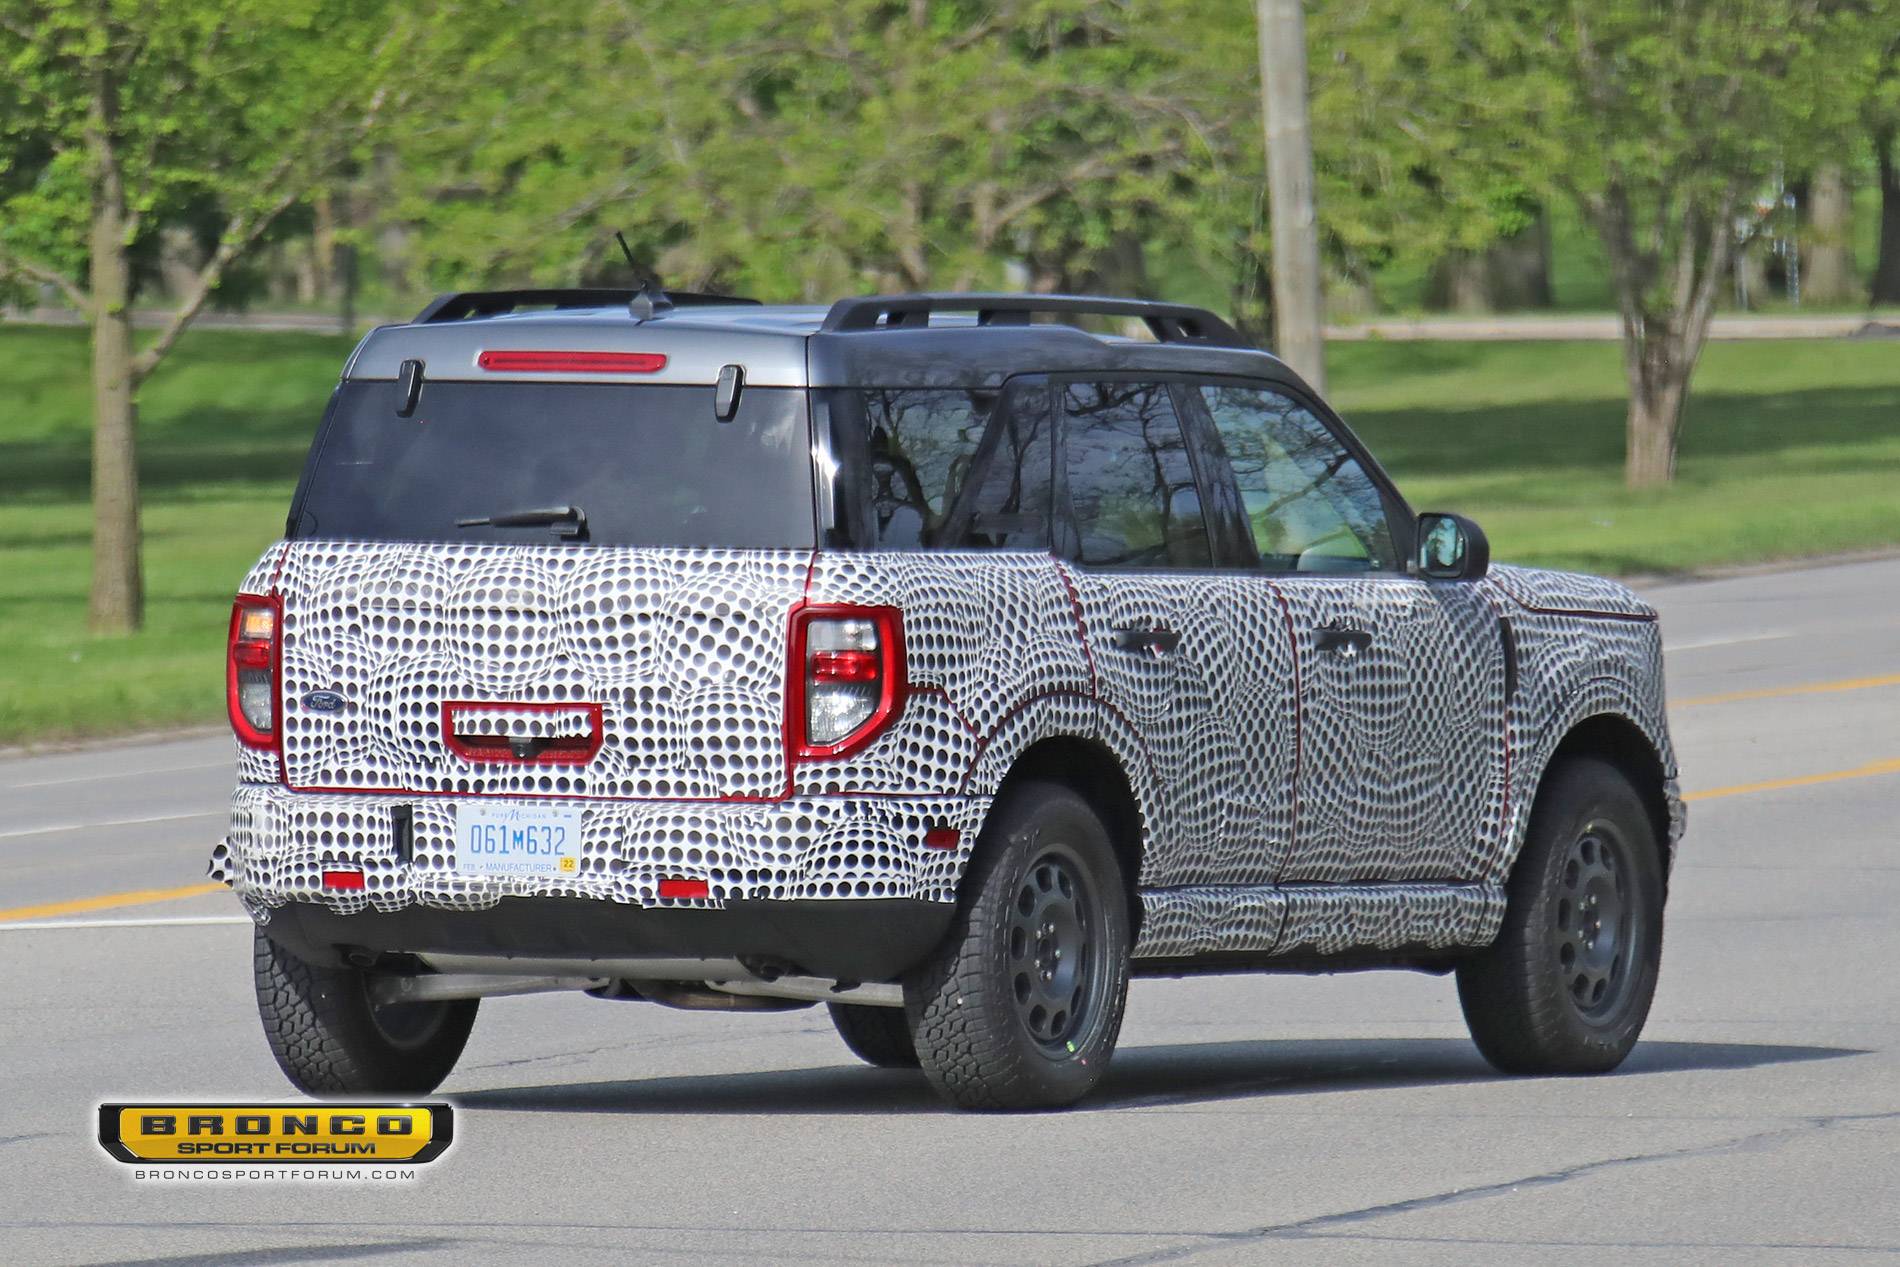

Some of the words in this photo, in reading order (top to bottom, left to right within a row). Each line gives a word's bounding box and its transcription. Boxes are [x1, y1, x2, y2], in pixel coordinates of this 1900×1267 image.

[311, 694, 337, 709] Ford
[471, 825, 566, 855] 061M632
[485, 863, 553, 872] MANUFACTURER
[563, 859, 575, 868] 22
